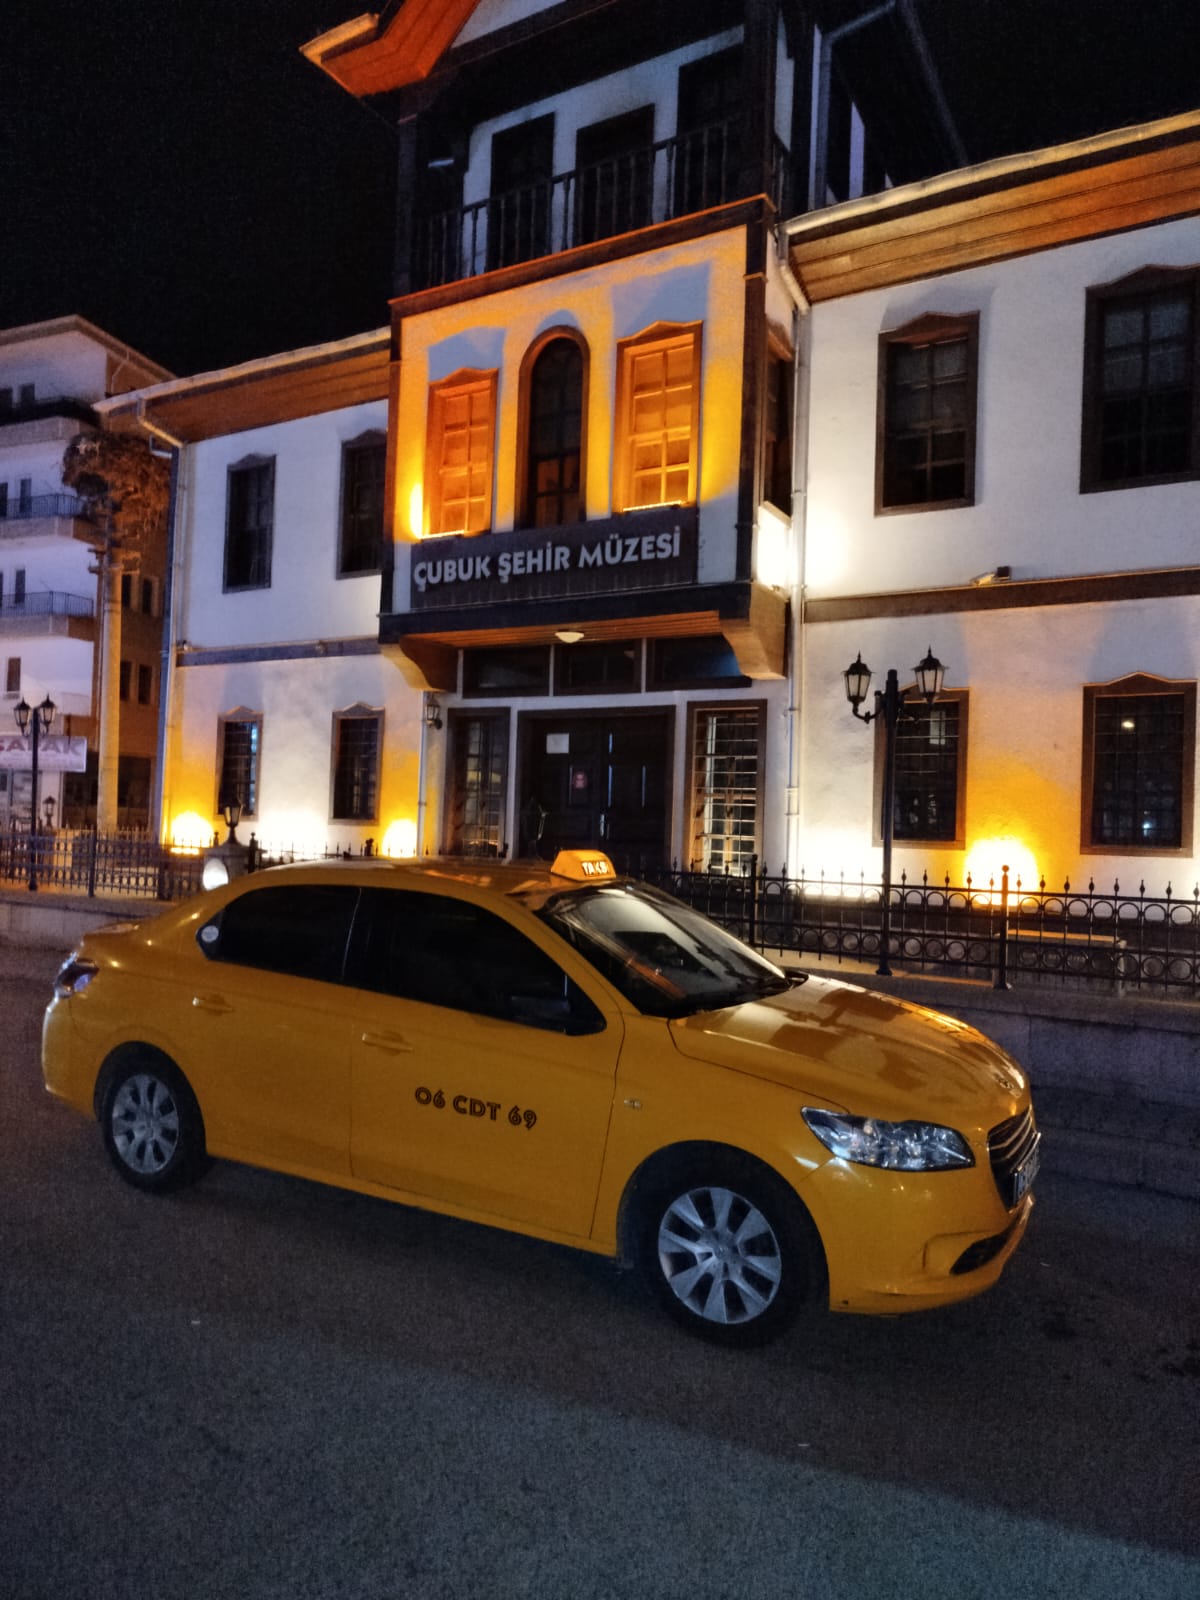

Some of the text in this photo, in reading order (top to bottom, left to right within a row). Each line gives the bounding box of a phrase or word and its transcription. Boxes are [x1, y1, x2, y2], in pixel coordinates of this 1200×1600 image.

[413, 525, 681, 592] ÇUBUK ŞEHİR MÜZESİ
[414, 1086, 538, 1130] 06 CDT 69
